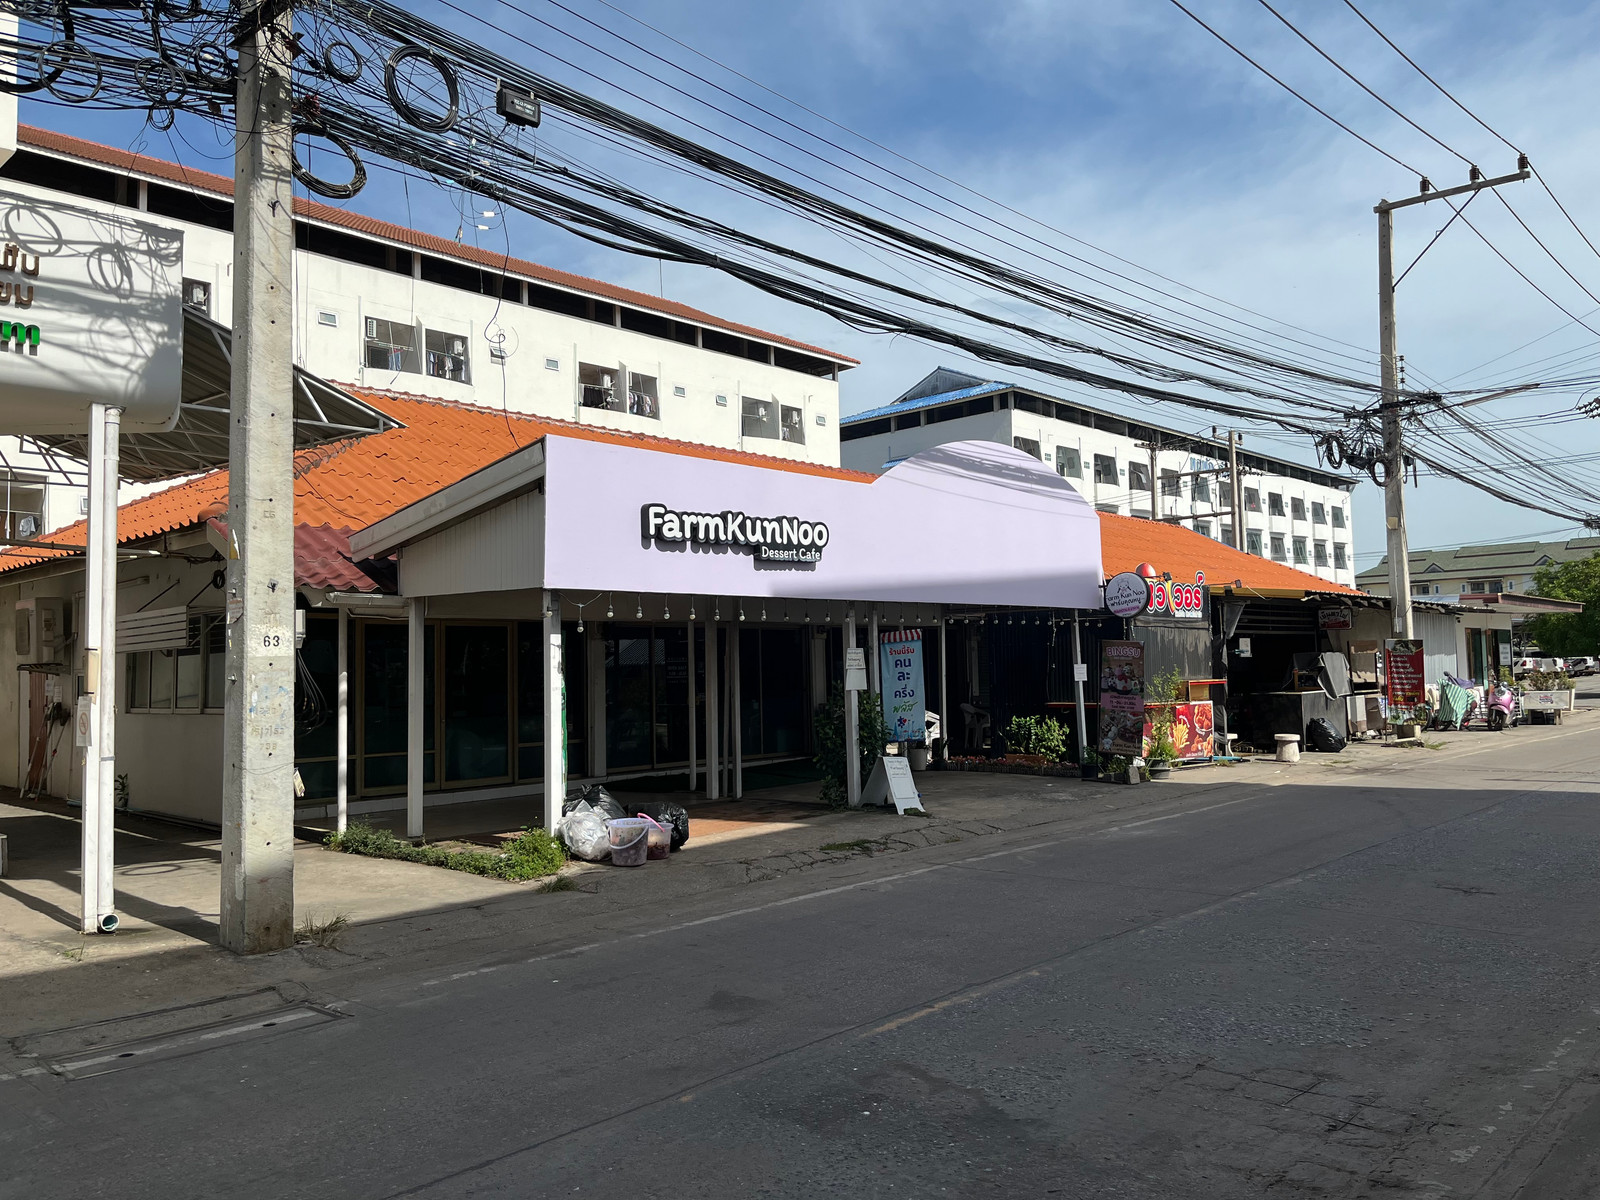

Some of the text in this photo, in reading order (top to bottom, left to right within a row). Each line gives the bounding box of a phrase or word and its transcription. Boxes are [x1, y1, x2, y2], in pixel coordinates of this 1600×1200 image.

[762, 546, 821, 560] Dessert Cafe
[263, 635, 280, 648] 63
[889, 645, 915, 656] ร้านนี้รับ
[1106, 646, 1141, 659] BINGSU
[895, 658, 912, 669] คน
[897, 671, 911, 681] ละ
[894, 683, 915, 699] ครึ่ง
[893, 701, 918, 714] พลัส
